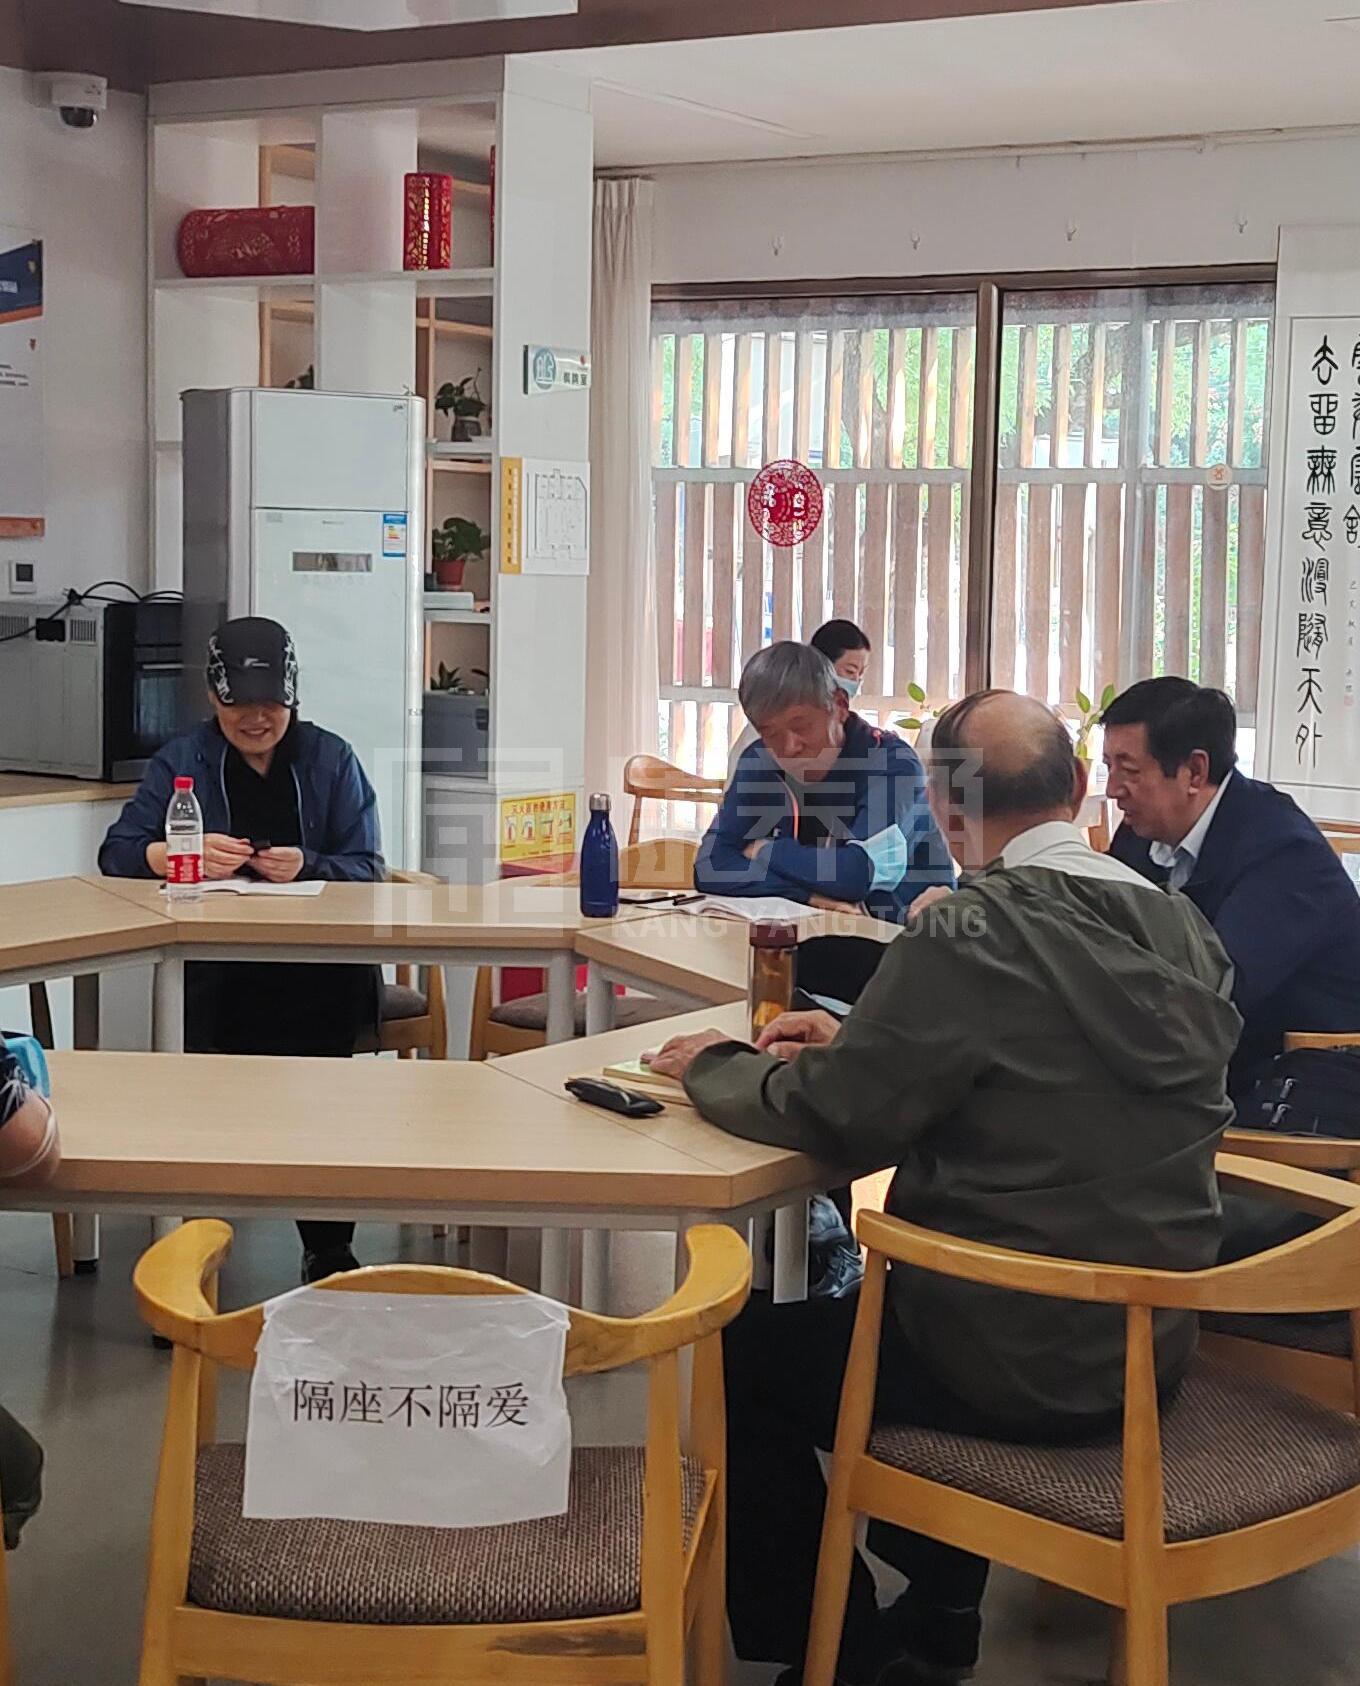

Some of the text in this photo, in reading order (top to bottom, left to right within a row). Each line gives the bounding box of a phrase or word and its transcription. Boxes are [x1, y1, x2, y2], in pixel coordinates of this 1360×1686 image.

[293, 1378, 530, 1430] 隔座不隔爱
